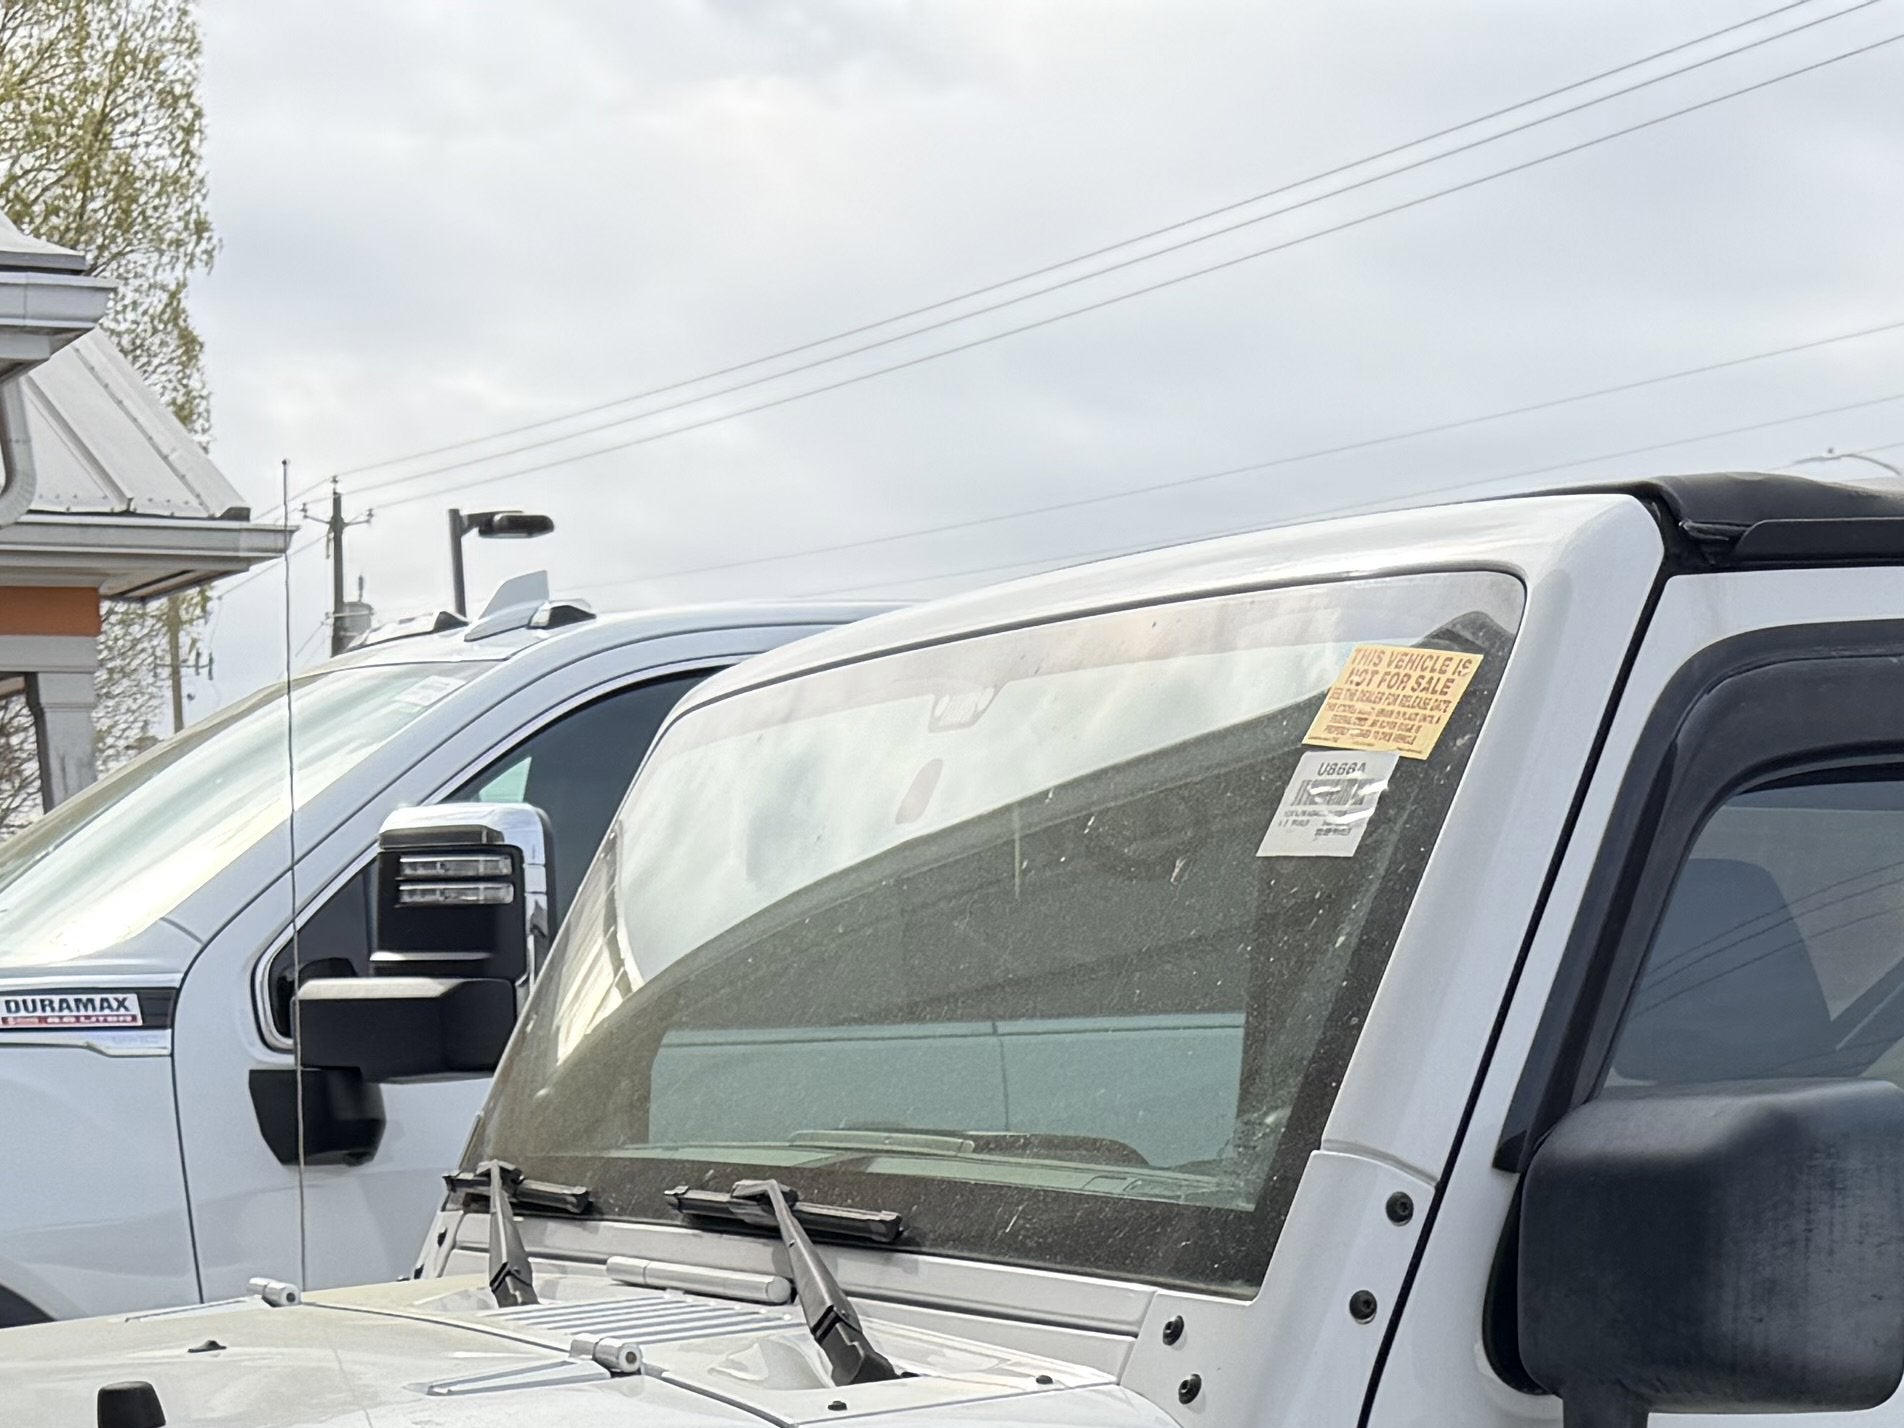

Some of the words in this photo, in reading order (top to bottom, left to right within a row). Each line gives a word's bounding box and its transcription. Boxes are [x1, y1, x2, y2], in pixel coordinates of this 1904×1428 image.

[1352, 648, 1386, 668] THIS
[1387, 651, 1454, 675] VEHICLE
[1345, 667, 1380, 687] NOT
[1377, 670, 1412, 691] FOR
[1410, 674, 1456, 696] SALE
[4, 996, 131, 1015] DURAMAX
